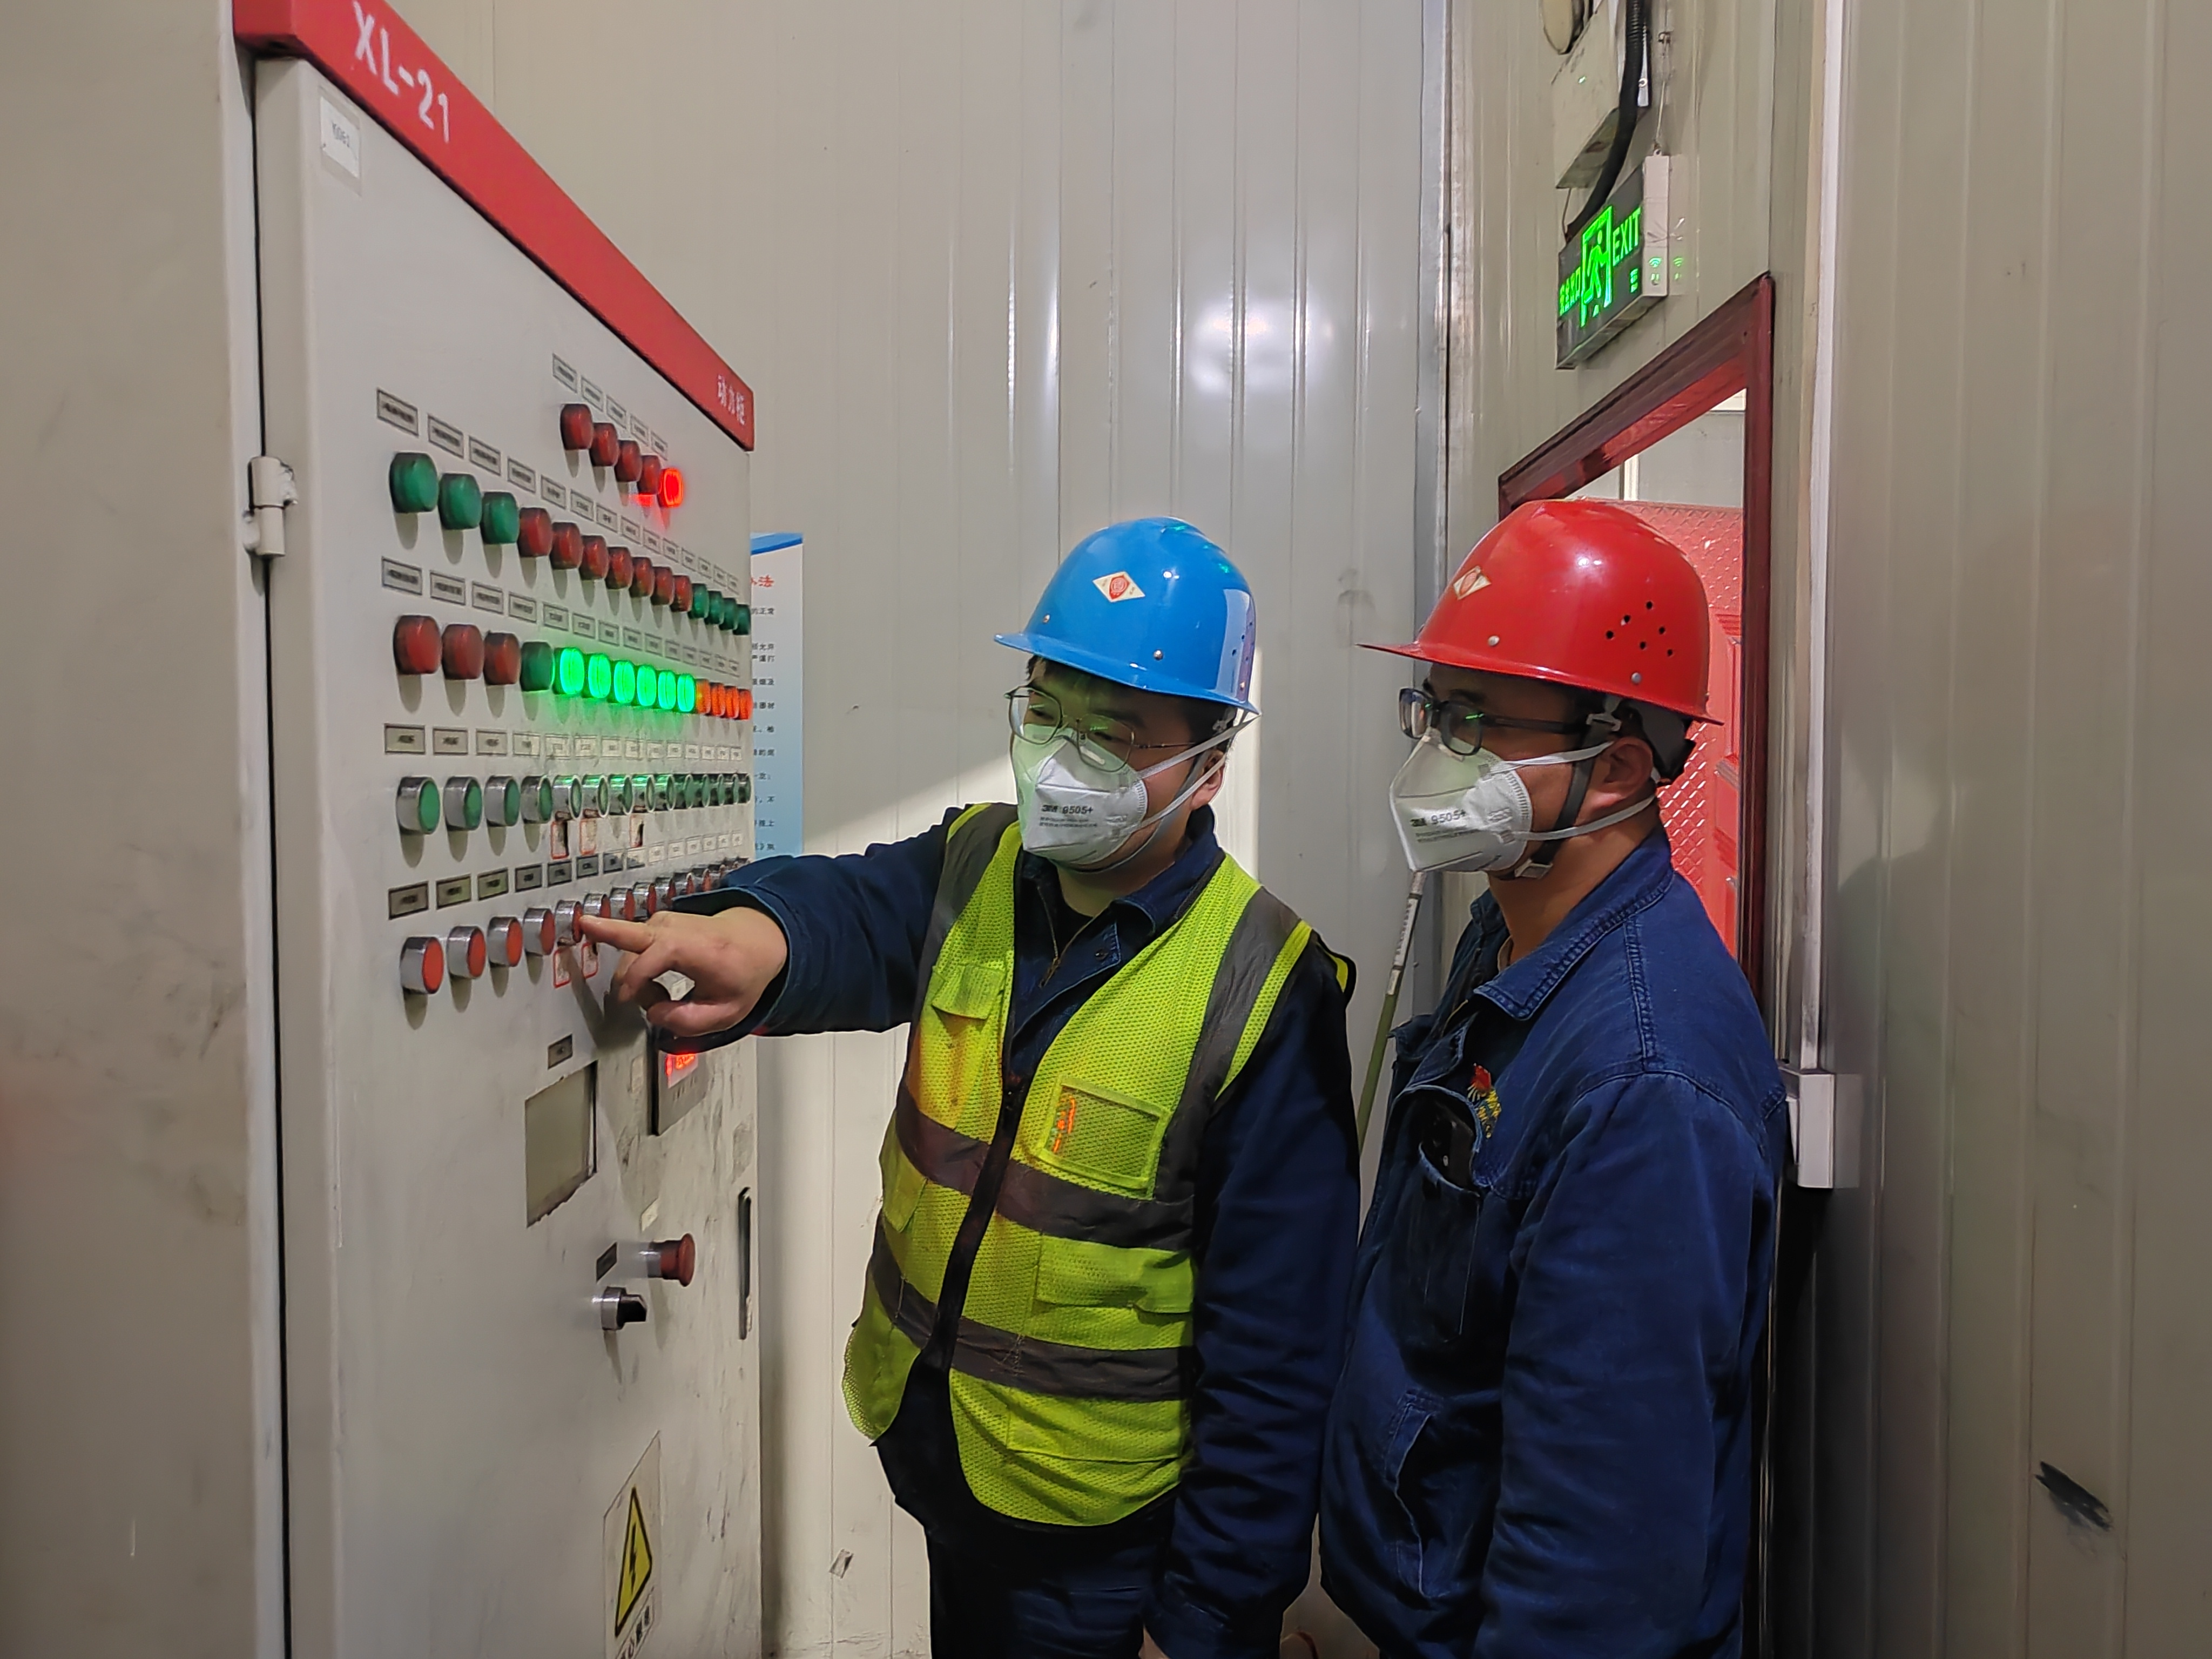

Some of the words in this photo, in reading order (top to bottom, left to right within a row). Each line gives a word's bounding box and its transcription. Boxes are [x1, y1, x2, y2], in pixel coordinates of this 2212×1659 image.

[353, 1, 449, 143] XL-21
[1613, 206, 1641, 267] EXIT
[1431, 810, 1466, 825] 9505+
